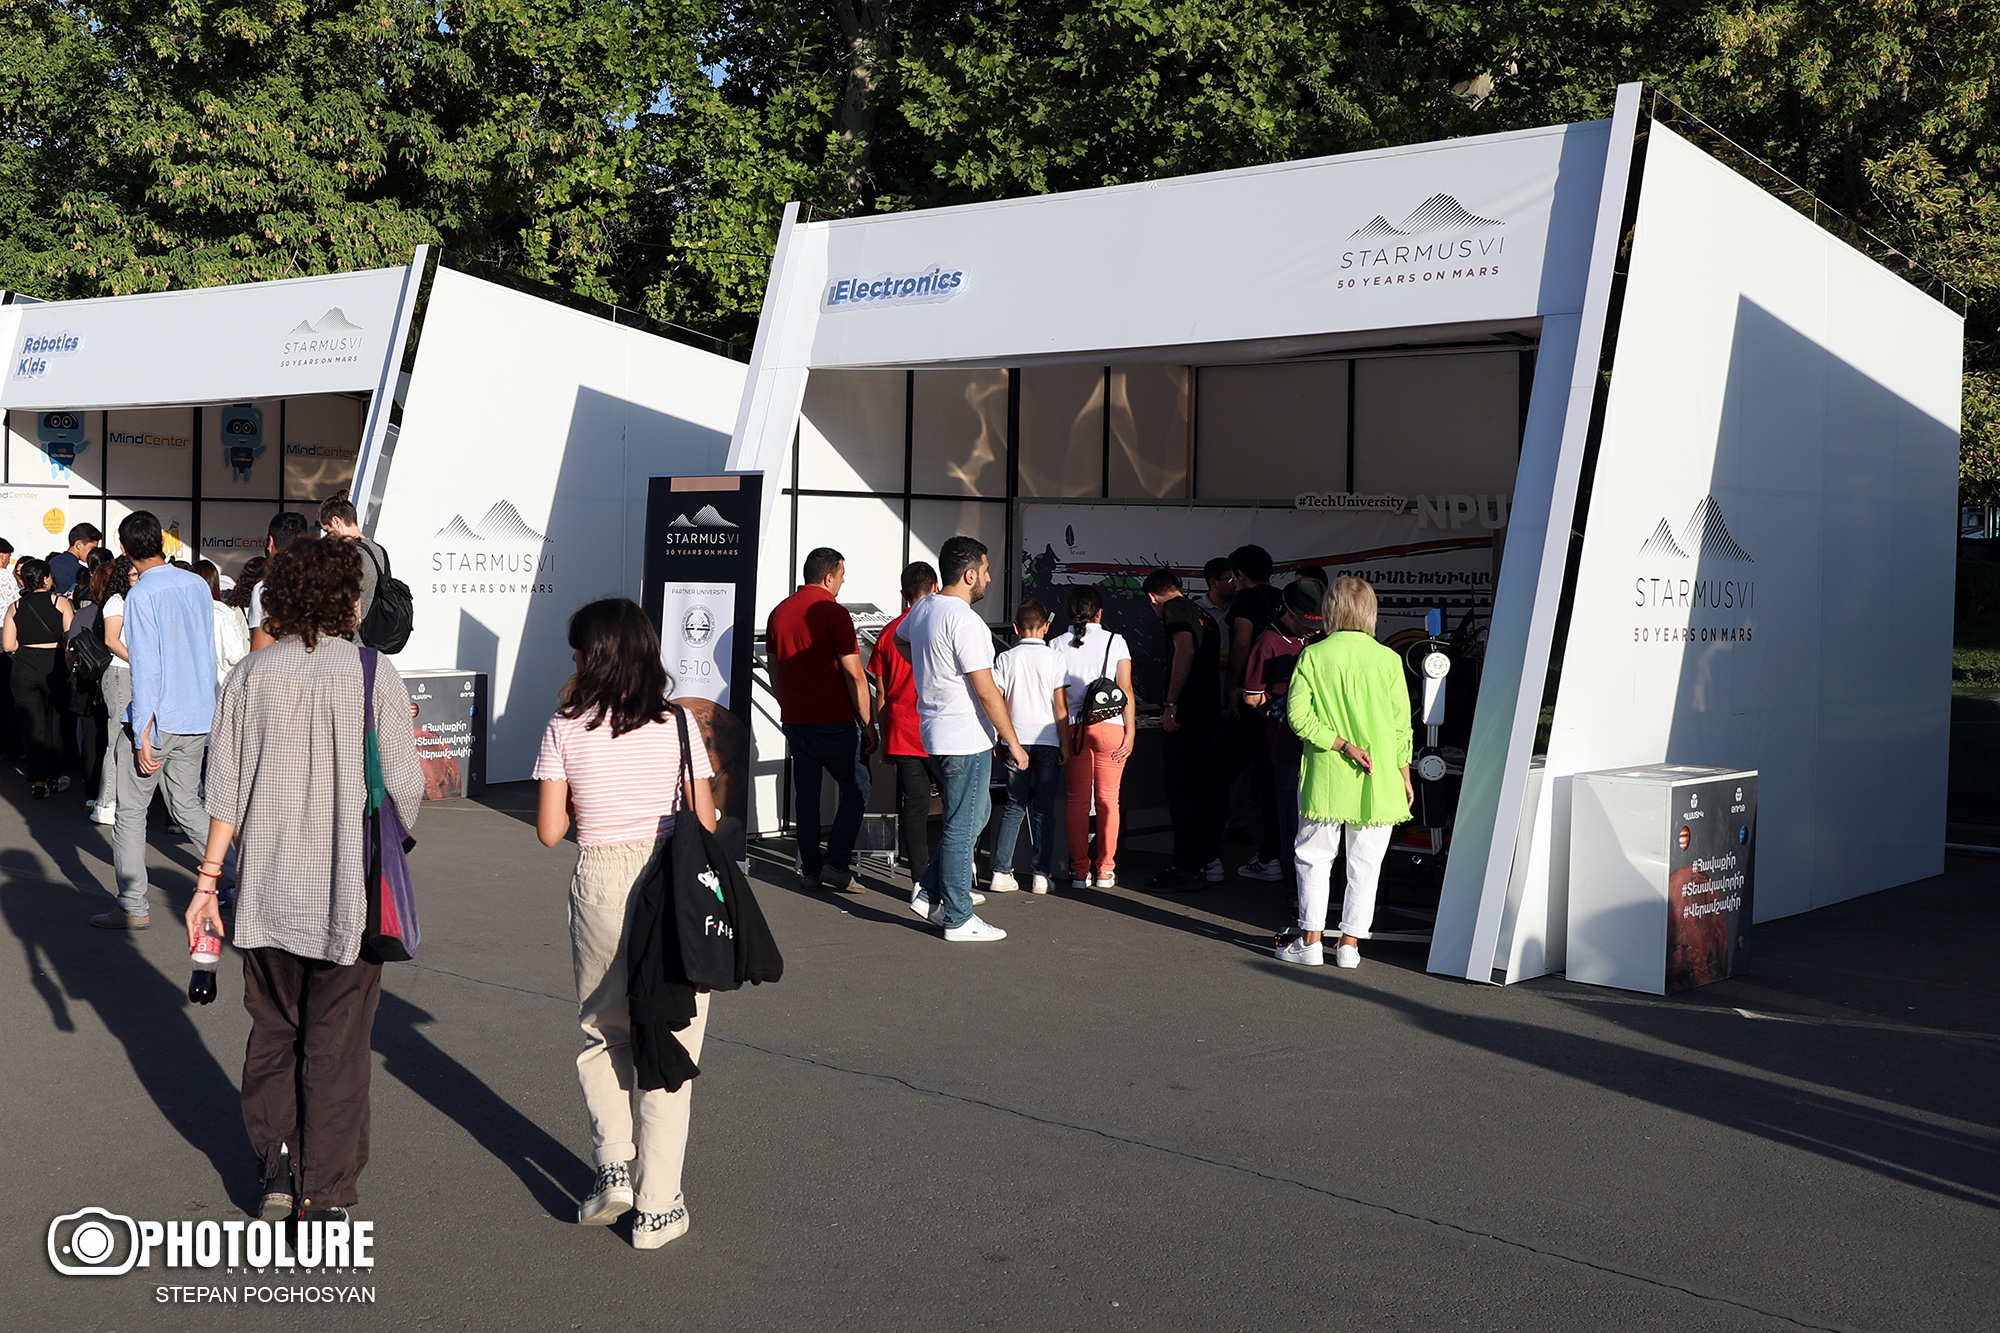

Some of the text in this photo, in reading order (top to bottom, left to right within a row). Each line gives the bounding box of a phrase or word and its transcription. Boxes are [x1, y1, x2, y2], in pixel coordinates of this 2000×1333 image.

[833, 268, 963, 302] Electronics
[1337, 265, 1499, 289] 50 YEARS ON MARS
[23, 333, 79, 354] Robotics
[17, 356, 47, 375] Kids
[280, 355, 358, 368] 50 YEARS ON MARS
[109, 431, 190, 447] MindCenter
[1298, 495, 1405, 511] #TechUniversity
[202, 537, 267, 548] MindCent
[432, 584, 553, 593] 50 YEARS ON MARS
[1633, 627, 1752, 642] 50 YEARS ON MARS
[678, 659, 711, 676] 5-10
[678, 676, 711, 684] SEPTEMBER
